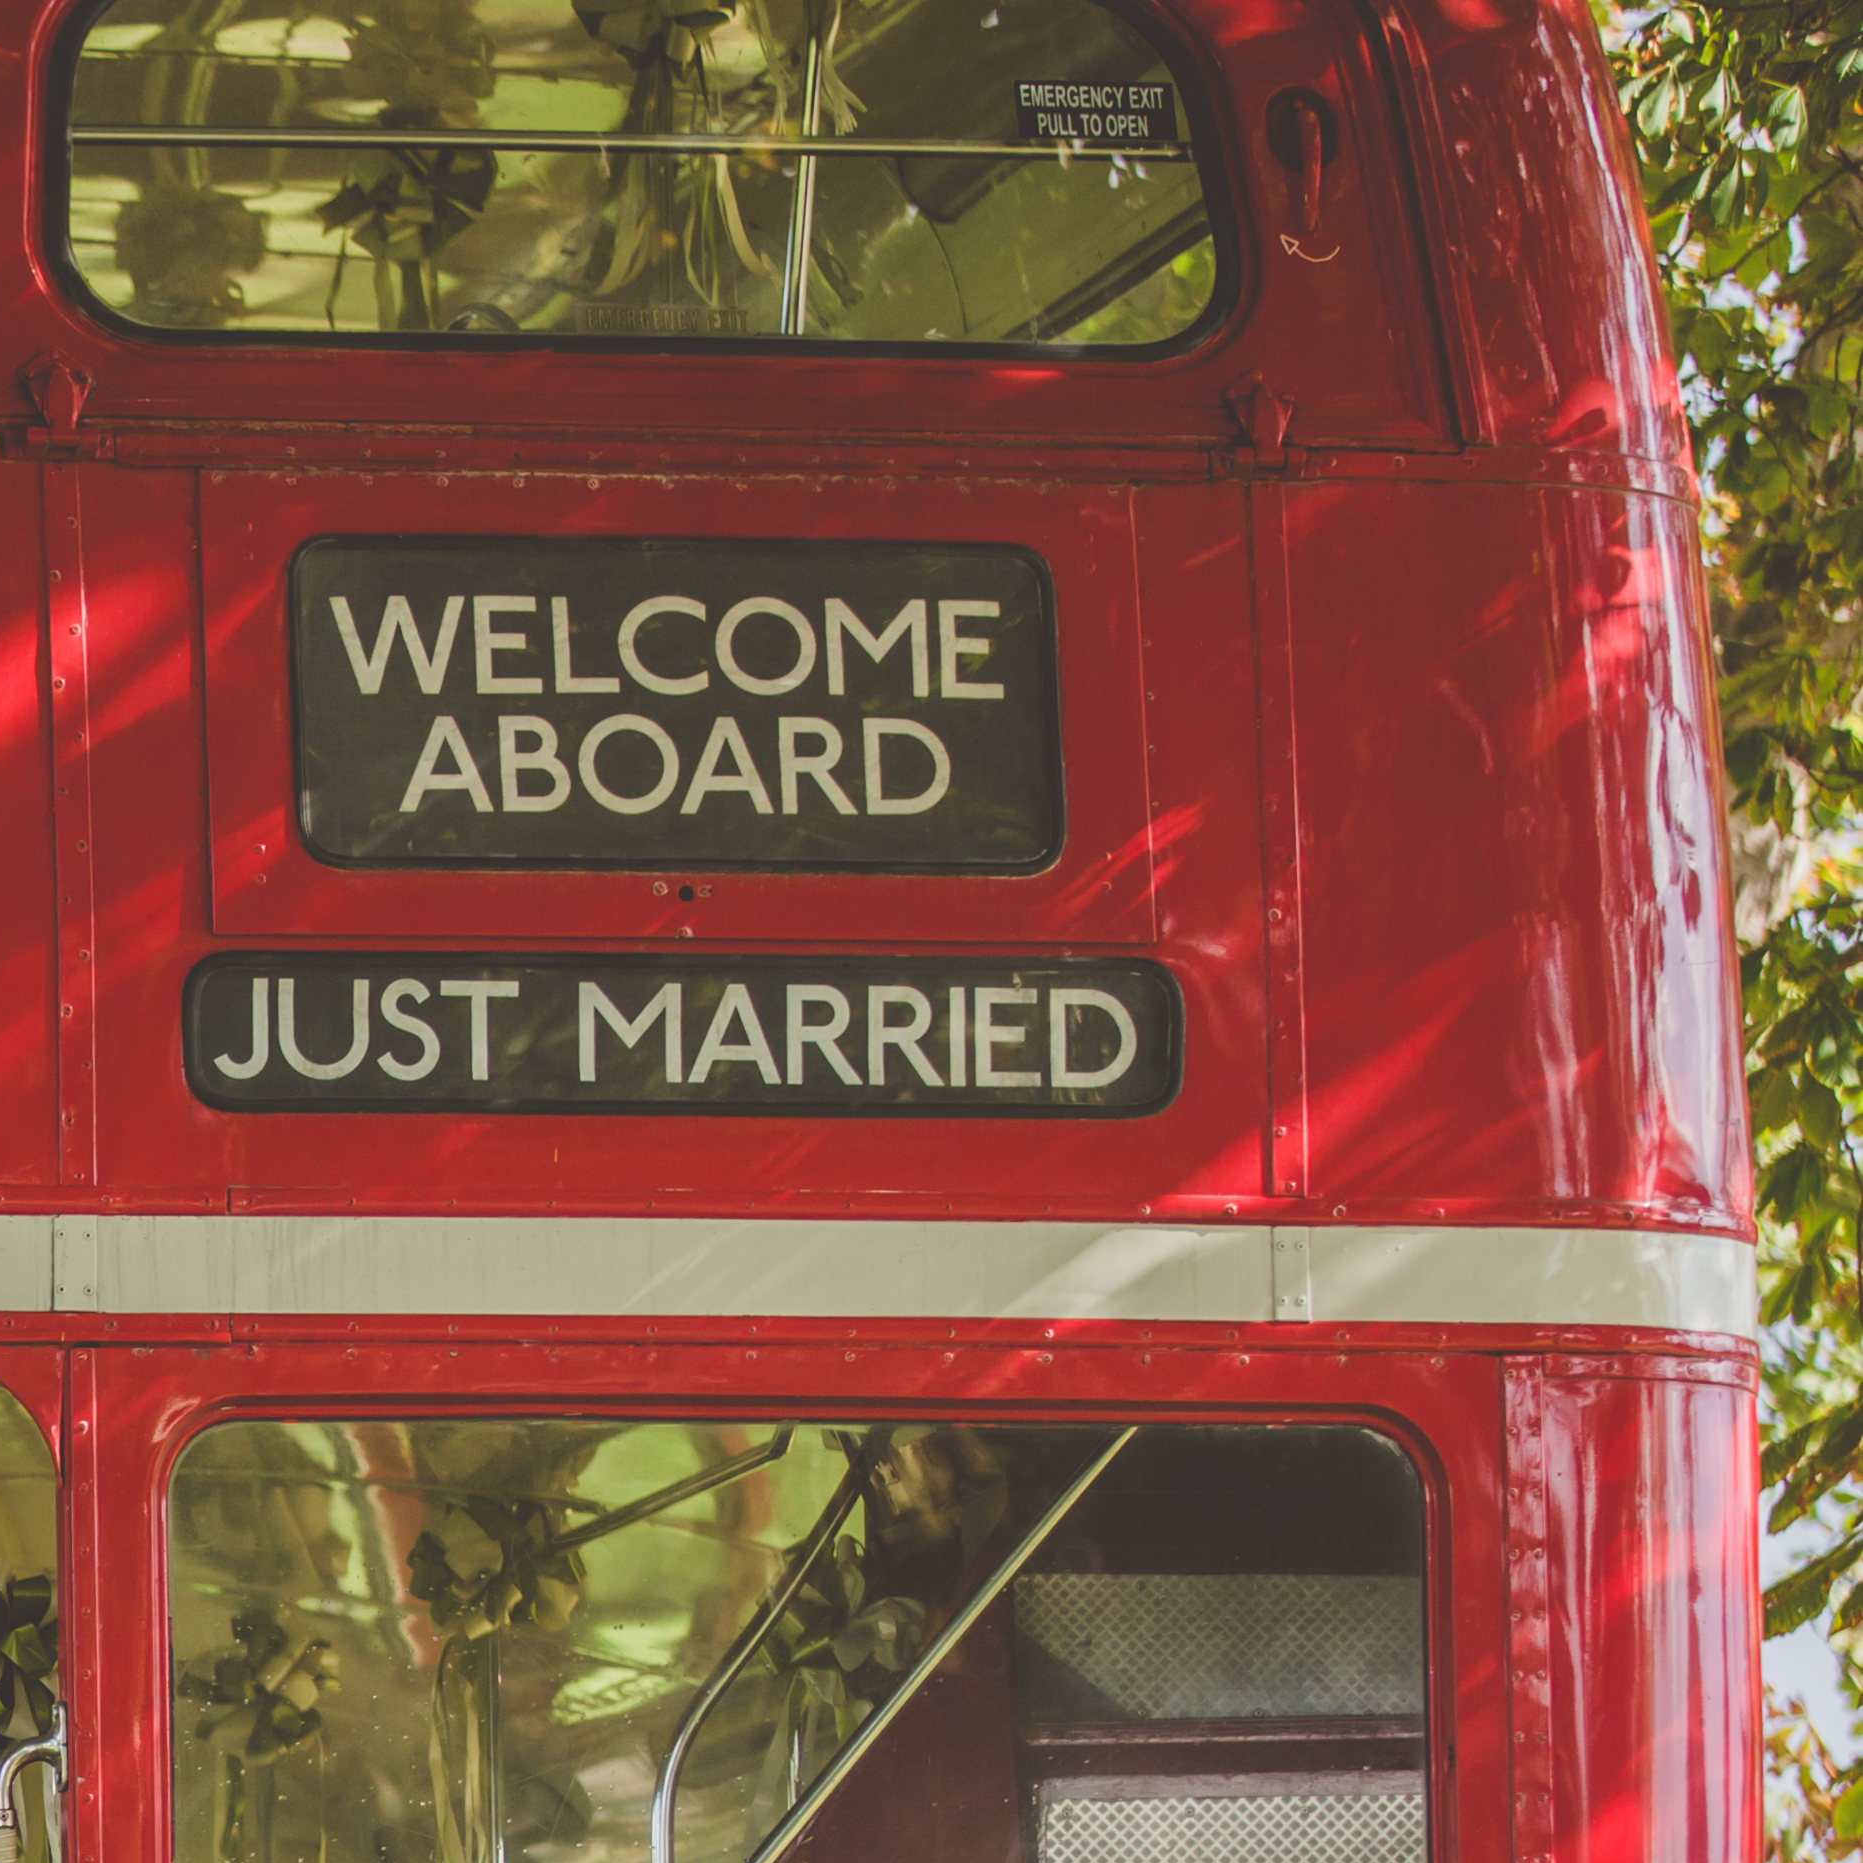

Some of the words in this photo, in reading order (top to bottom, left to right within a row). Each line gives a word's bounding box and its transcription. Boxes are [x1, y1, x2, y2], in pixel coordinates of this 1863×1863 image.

[1019, 84, 1124, 109] EMERGENCY
[1128, 86, 1164, 109] EXIT
[1037, 113, 1078, 136] PULL
[1080, 113, 1102, 137] TO
[1106, 114, 1149, 137] OPEN
[586, 308, 699, 331] EMERGENCY
[707, 309, 747, 332] EXIT
[329, 594, 1005, 700] WELCOME
[399, 713, 952, 815] ABOARD
[213, 976, 519, 1081] JUST
[579, 980, 1139, 1089] MARRIED
